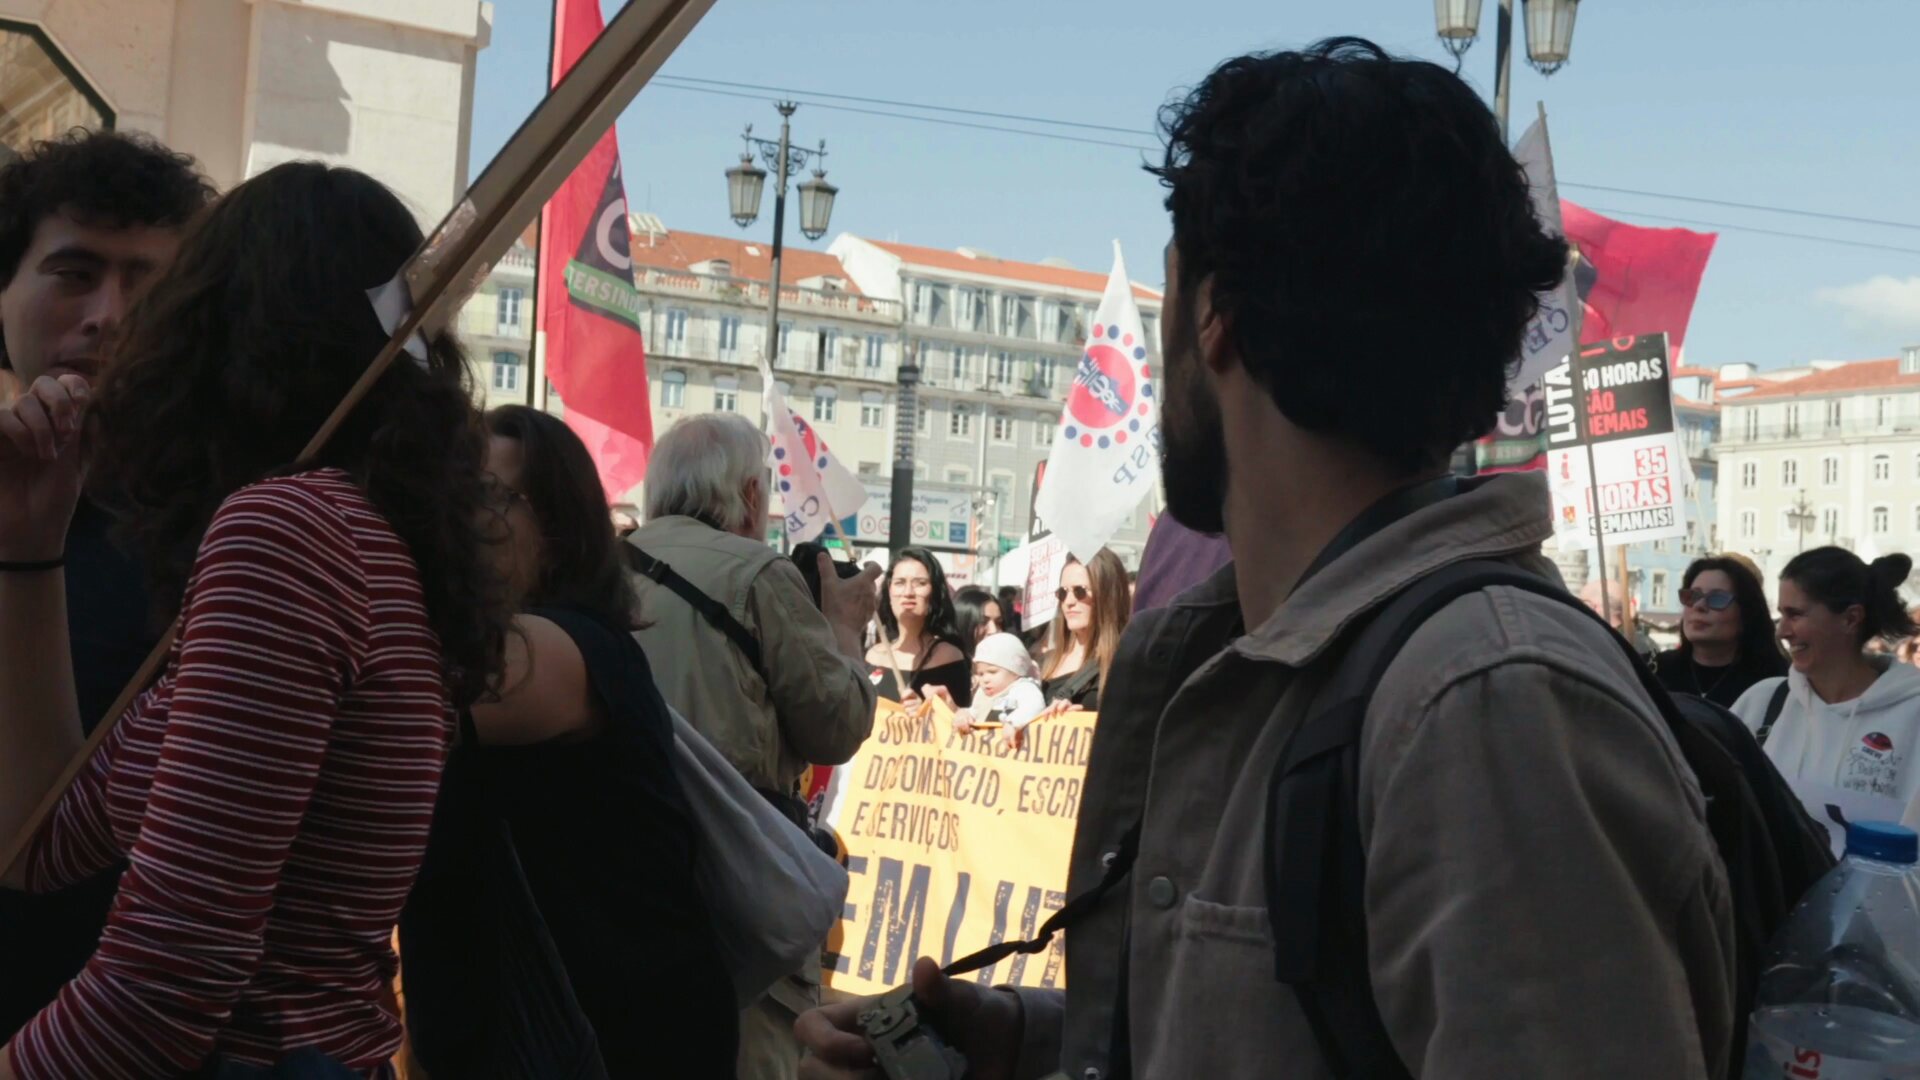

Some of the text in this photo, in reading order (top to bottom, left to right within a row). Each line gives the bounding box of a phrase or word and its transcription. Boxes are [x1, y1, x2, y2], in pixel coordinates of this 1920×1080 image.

[1601, 357, 1663, 388] HORAS
[1636, 447, 1667, 476] 35
[1588, 477, 1669, 513] HORAS
[1589, 507, 1673, 535] SEMANAIS!
